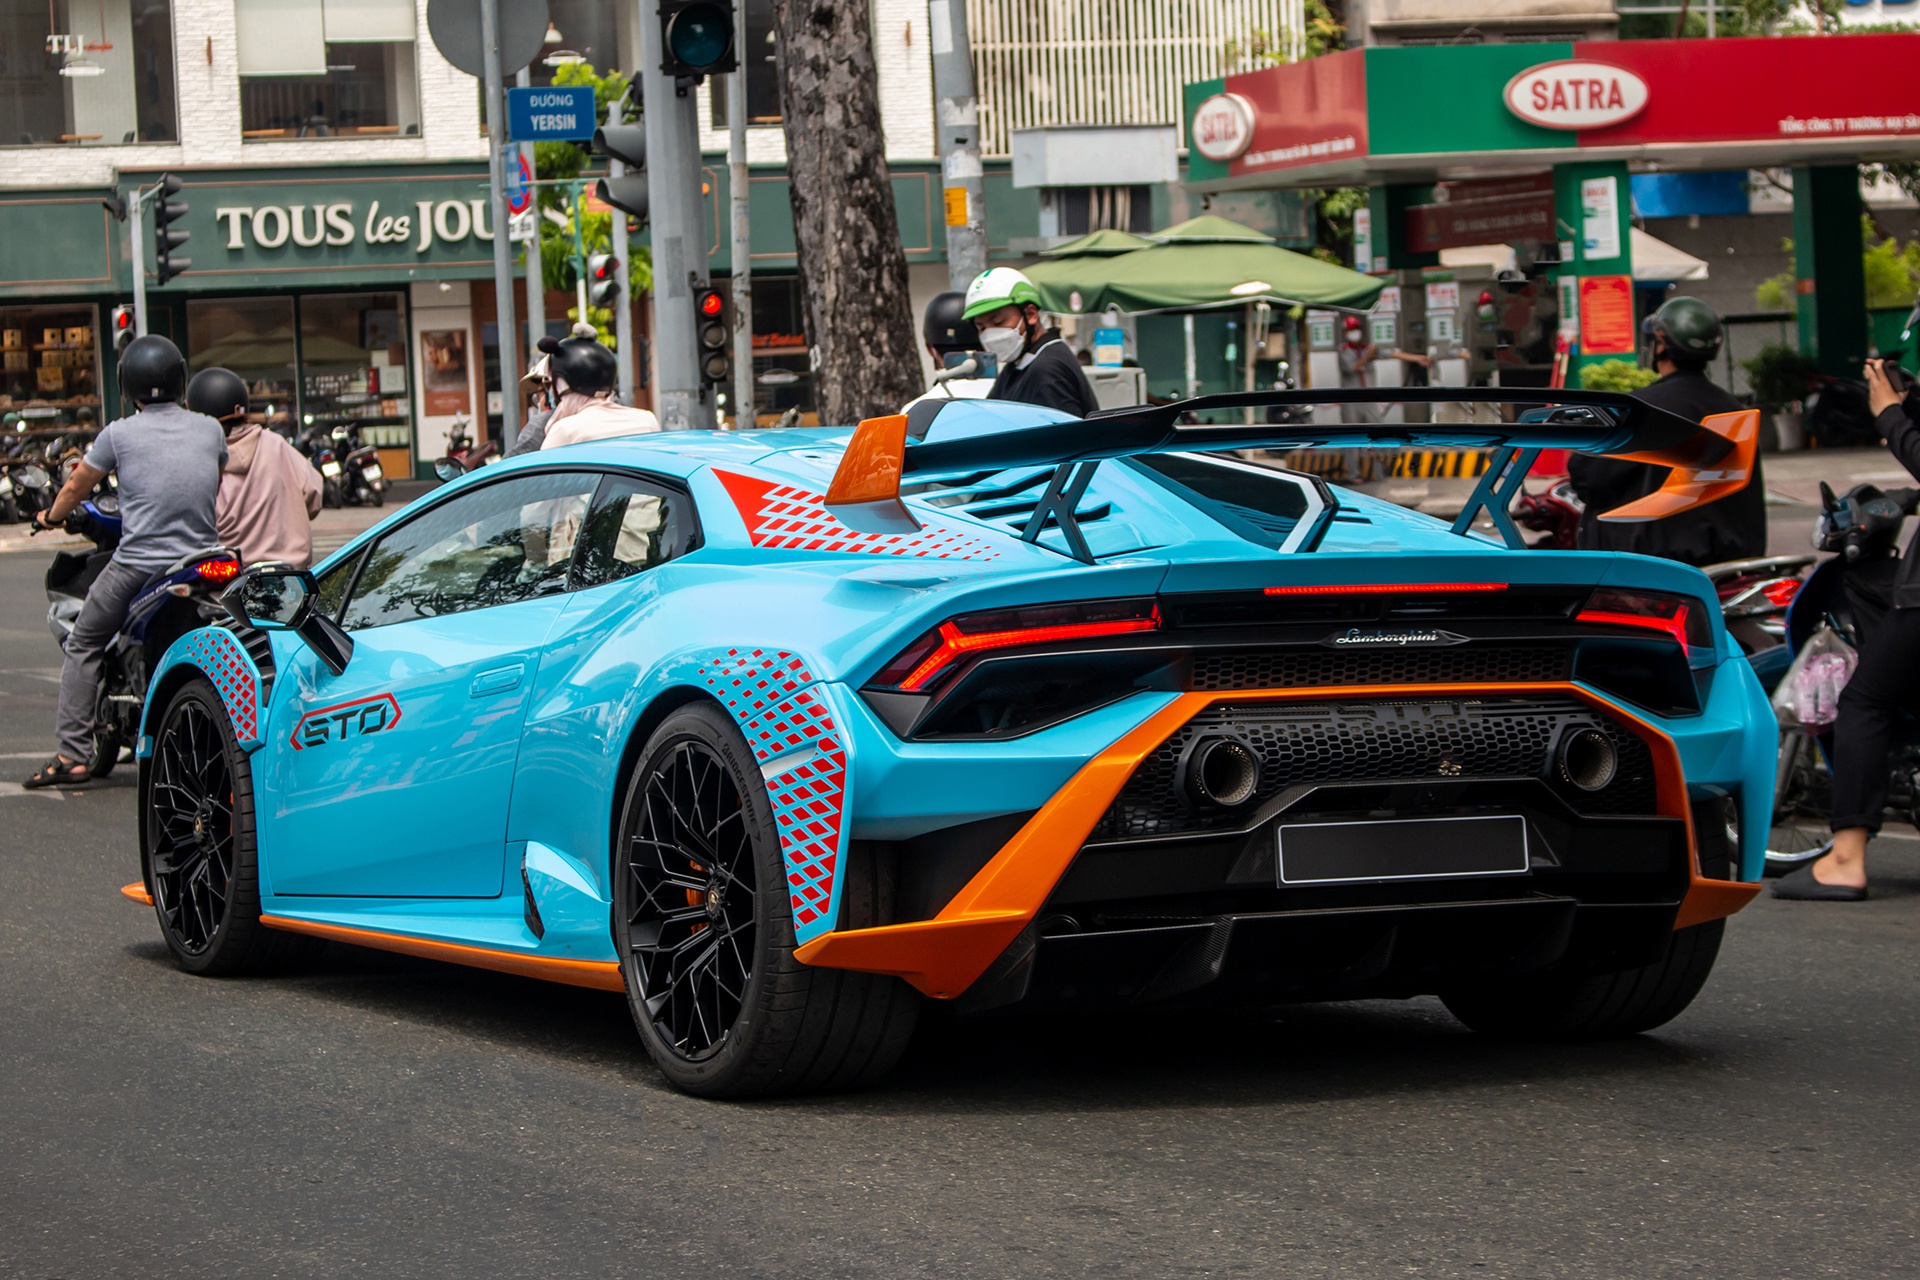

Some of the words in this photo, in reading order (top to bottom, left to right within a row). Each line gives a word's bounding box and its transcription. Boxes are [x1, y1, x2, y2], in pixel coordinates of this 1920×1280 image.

[46, 34, 84, 56] TLJ
[530, 92, 574, 107] ĐƯỜNG
[1531, 78, 1625, 111] SATRA
[530, 114, 576, 131] YERSIN
[216, 203, 356, 249] TOUS
[365, 200, 411, 244] les
[1336, 628, 1438, 645] Lamborghini
[304, 702, 387, 747] STO
